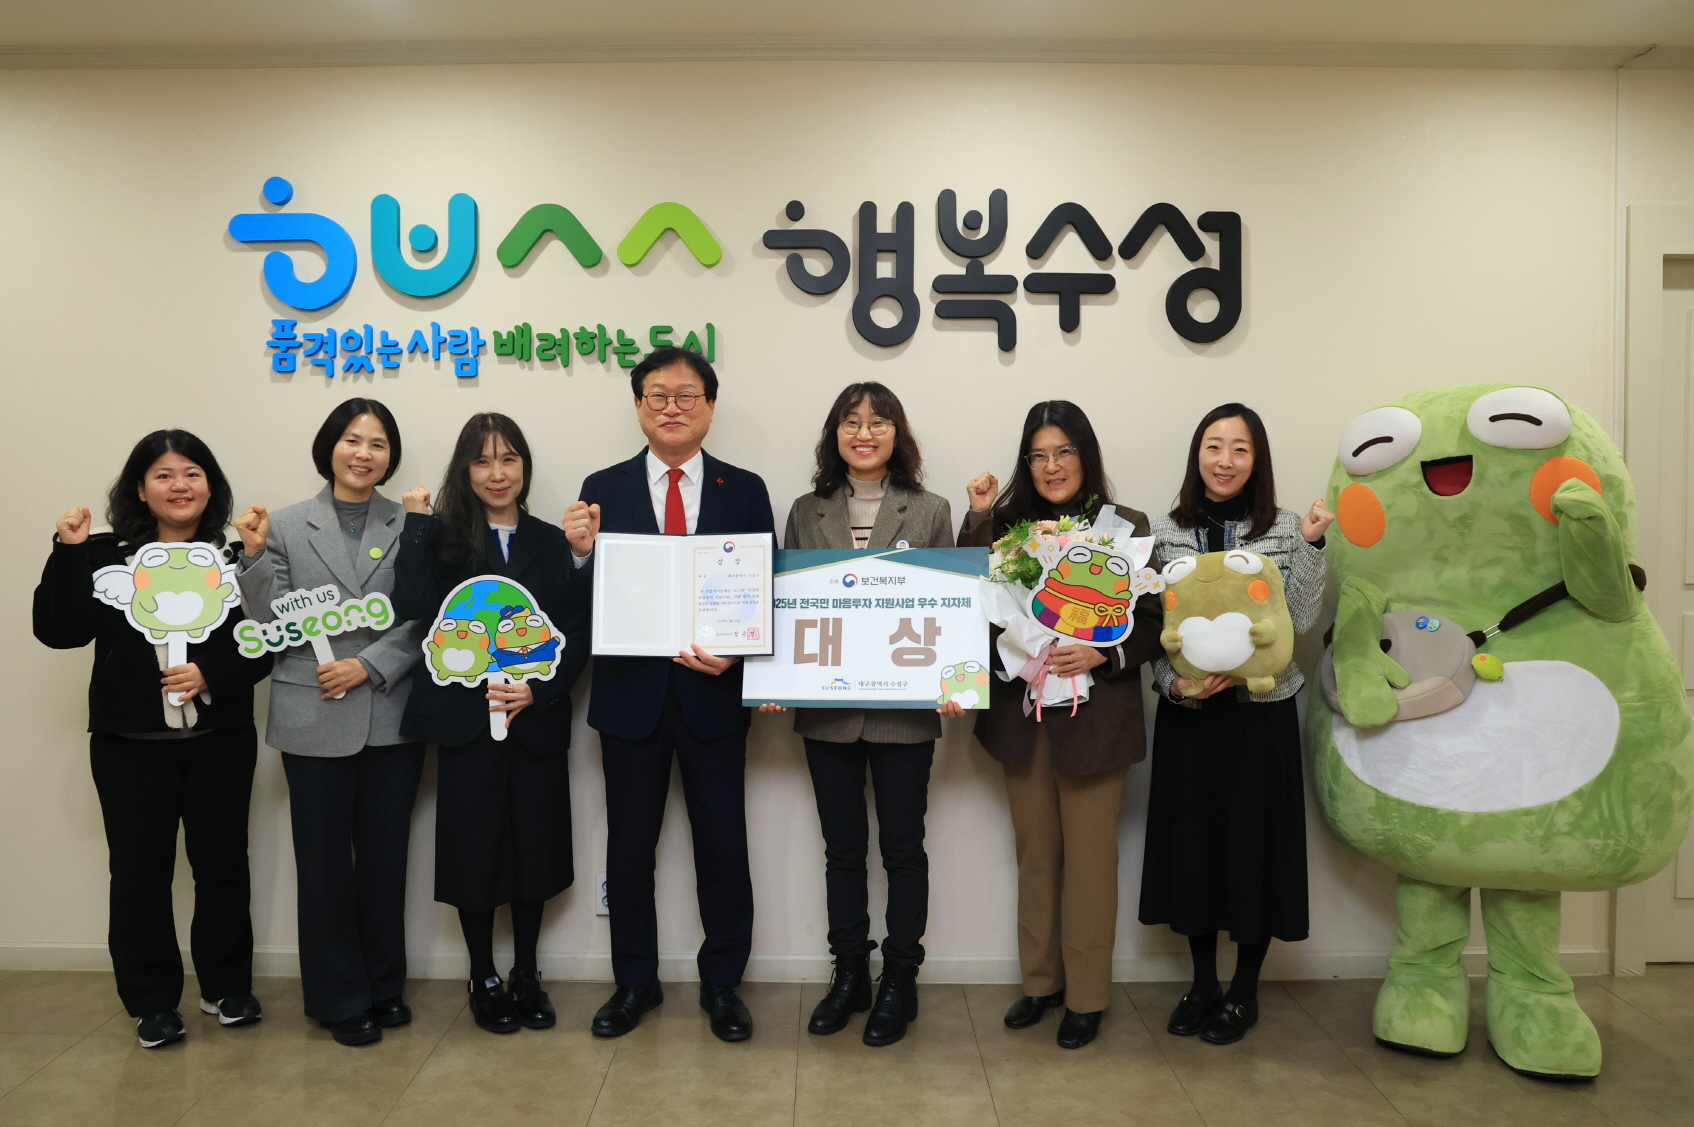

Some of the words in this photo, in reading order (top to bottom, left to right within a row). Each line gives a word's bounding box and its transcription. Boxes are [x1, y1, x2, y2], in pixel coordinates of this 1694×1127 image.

[763, 188, 1242, 352] 행복수성
[861, 576, 906, 586] 보건복지부
[276, 594, 313, 614] with
[316, 590, 335, 603] us
[774, 598, 797, 609] 25년
[799, 598, 829, 609] 전국민
[832, 598, 872, 609] 마음투자
[874, 598, 915, 609] 지원사업
[917, 598, 938, 608] 우수
[940, 597, 971, 608] 지자체
[1068, 607, 1090, 625] 福
[238, 598, 389, 654] Suseong
[858, 680, 889, 688] 대구광역시
[890, 680, 908, 688] 수성구
